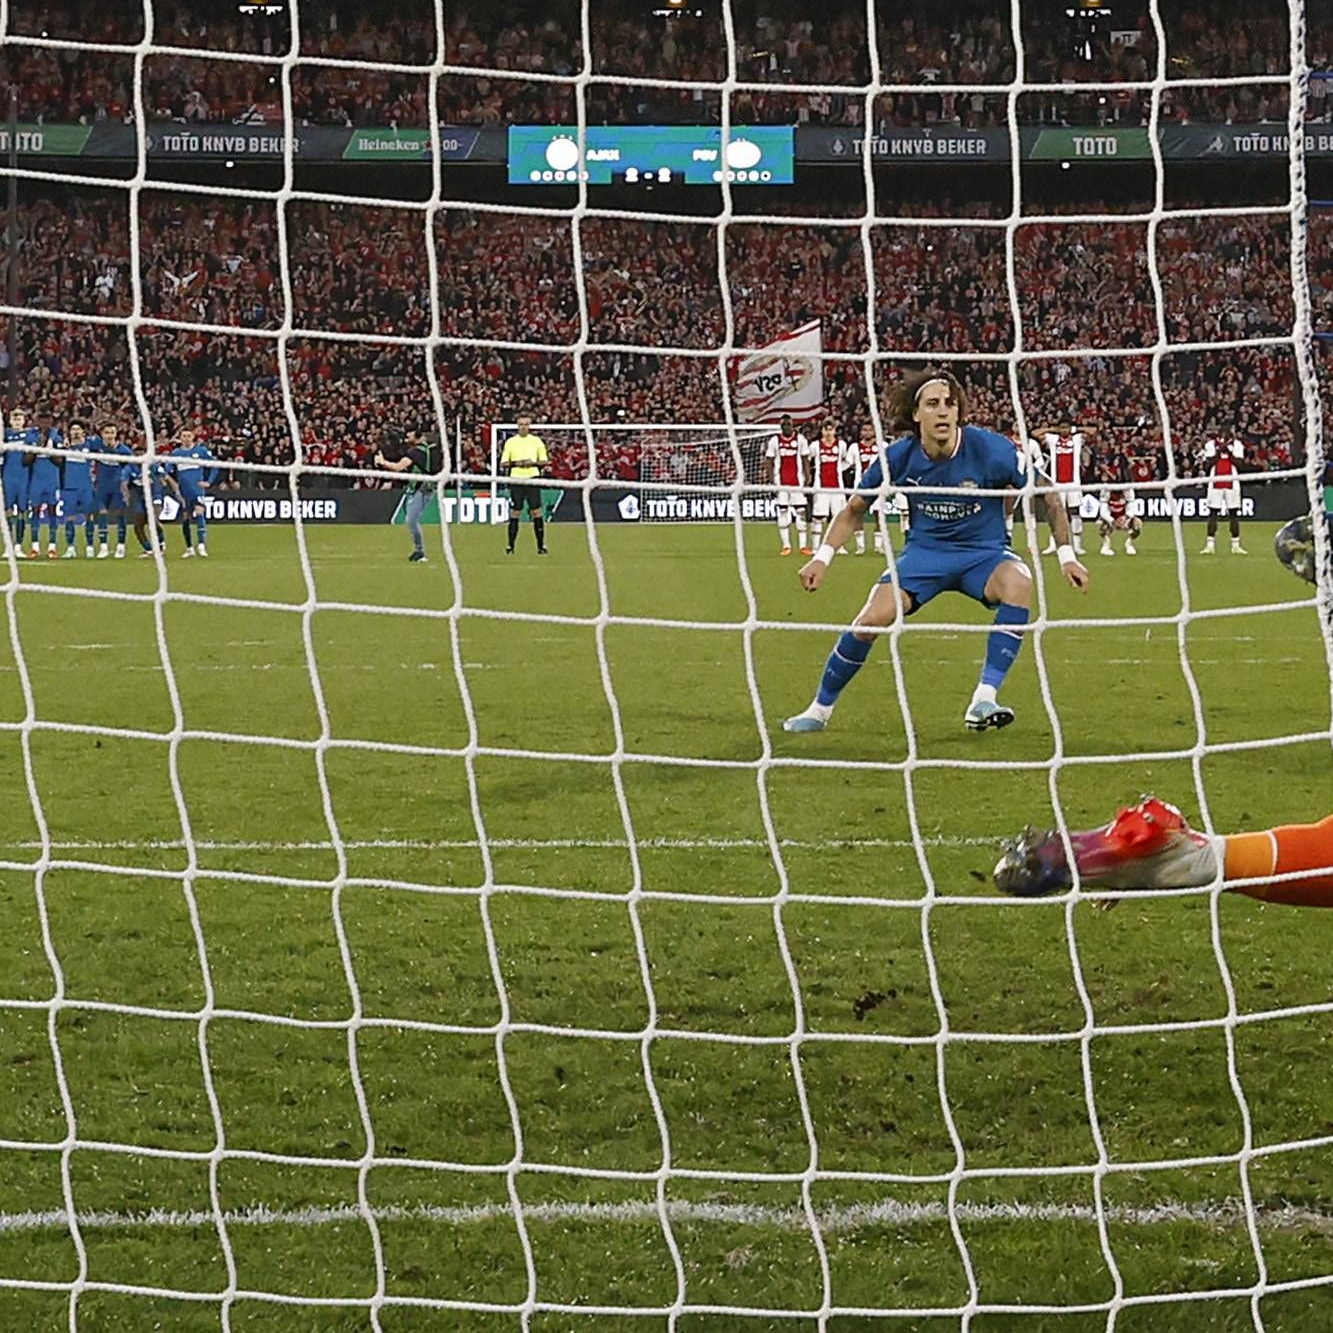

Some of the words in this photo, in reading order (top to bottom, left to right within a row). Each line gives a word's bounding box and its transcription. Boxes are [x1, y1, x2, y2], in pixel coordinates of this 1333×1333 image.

[163, 132, 199, 152] TOTO
[202, 136, 246, 153] KNVB
[358, 137, 419, 153] Heineken
[852, 136, 888, 155] TTO
[891, 139, 934, 155] KNVB
[937, 139, 986, 155] BEKER
[1072, 137, 1118, 156] TOTO
[1233, 132, 1269, 152] TOTO
[1272, 136, 1315, 151] KNB
[204, 496, 225, 519] TO
[227, 500, 277, 519] KNVB
[280, 500, 337, 519] BEKER
[647, 495, 688, 518] TOTO
[691, 499, 736, 518] KNVB
[743, 499, 797, 518] BEK
[1147, 498, 1196, 517] KNVB
